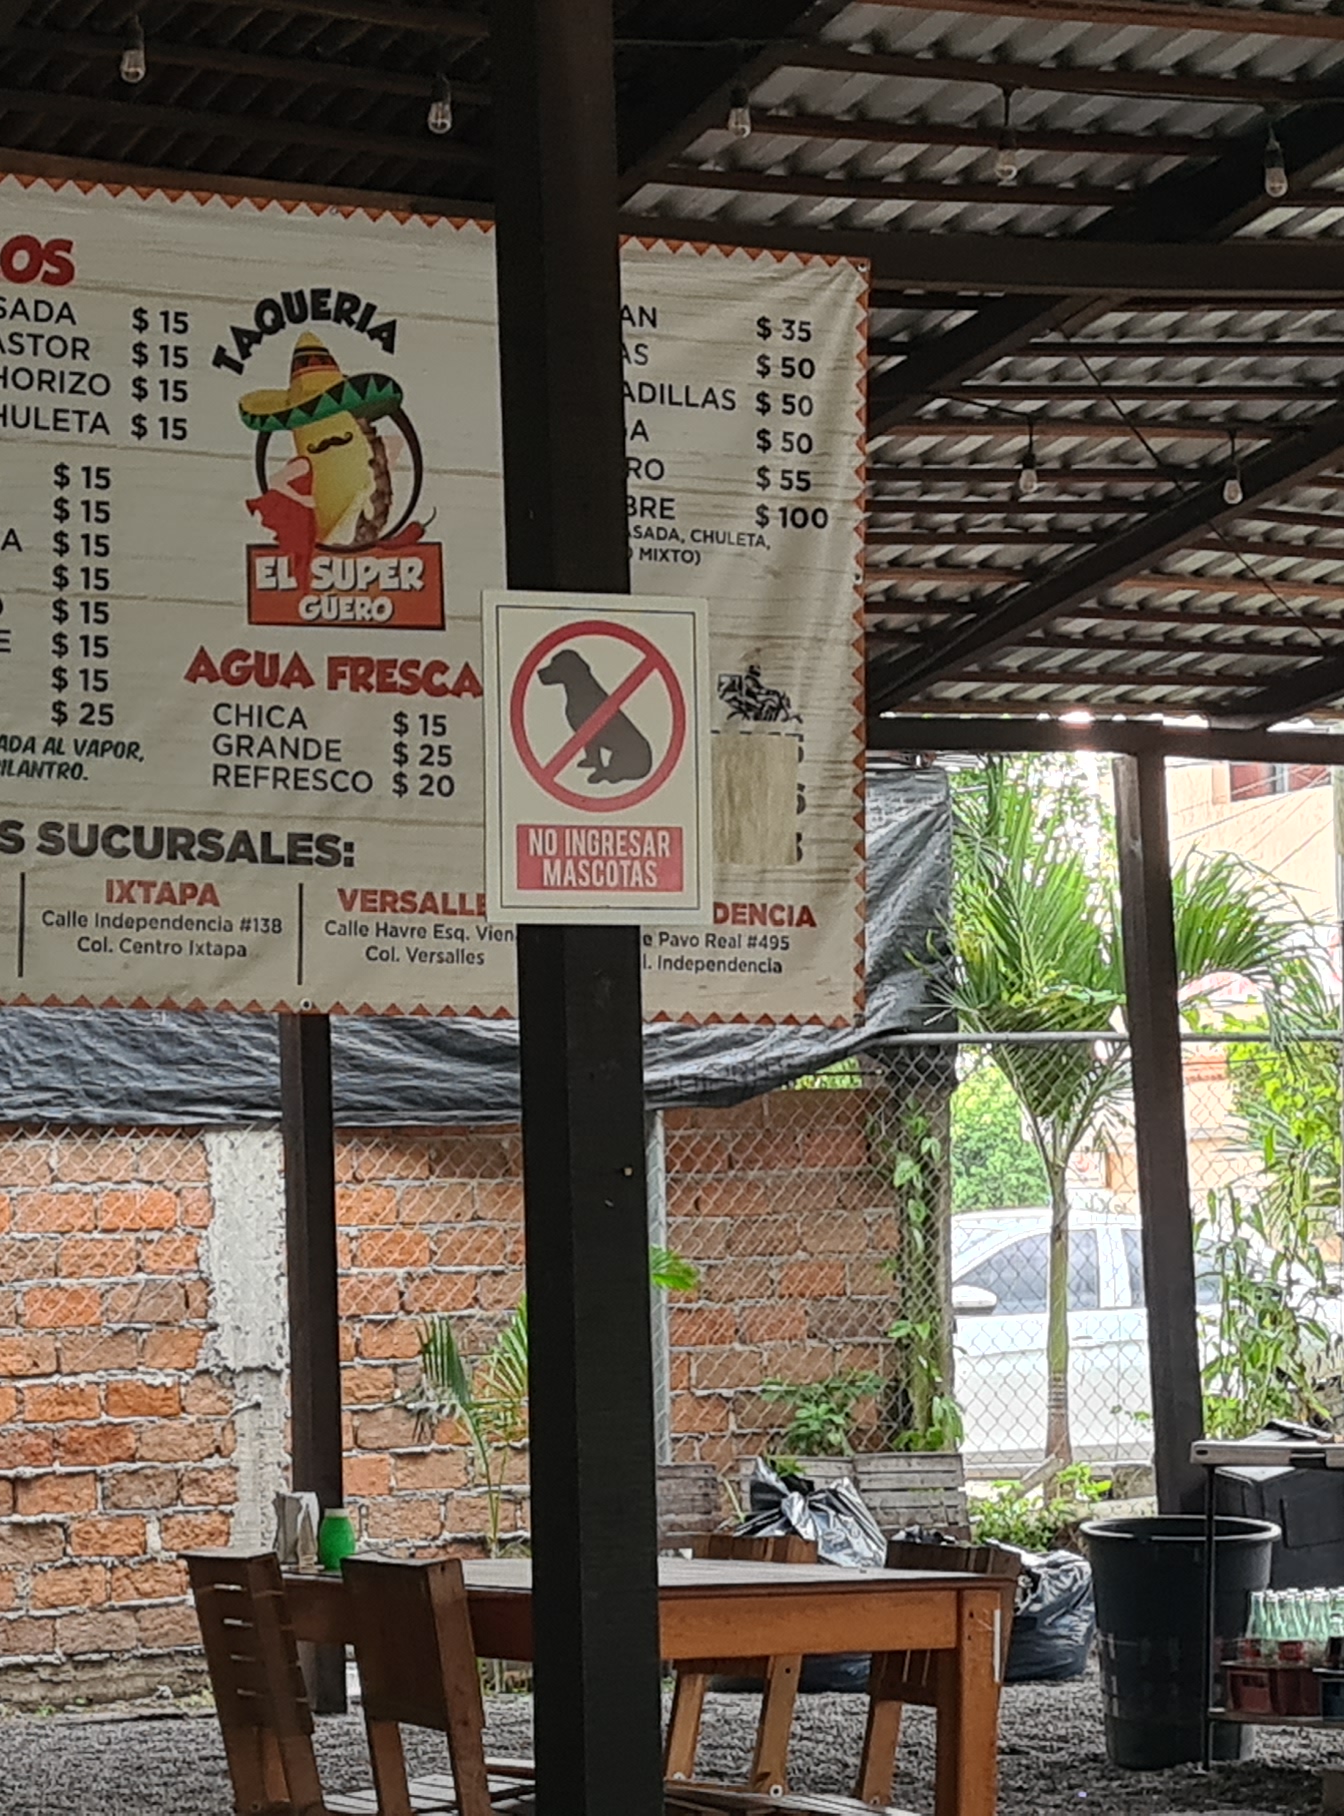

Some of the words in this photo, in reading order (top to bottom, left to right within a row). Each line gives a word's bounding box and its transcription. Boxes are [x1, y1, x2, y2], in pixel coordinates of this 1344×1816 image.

[132, 306, 150, 335] $
[159, 310, 189, 335] 15
[212, 288, 397, 375] TAQUERIA
[620, 304, 657, 329] AN
[756, 315, 773, 341] $
[781, 318, 812, 343] 35
[131, 340, 149, 369] $
[159, 344, 189, 369] 15
[622, 342, 648, 366] AS
[756, 353, 771, 380] $
[780, 356, 816, 380] 50
[131, 375, 149, 403] $
[158, 378, 188, 403] 15
[622, 382, 737, 411] ADILLAS
[755, 390, 772, 417] $
[781, 393, 814, 417] 50
[130, 413, 148, 441] $
[158, 416, 188, 441] 15
[756, 427, 772, 454] $
[781, 431, 814, 455] 50
[53, 462, 71, 491] $
[81, 465, 111, 491] 15
[627, 458, 664, 481] RO
[756, 464, 771, 492] $
[779, 469, 812, 493] 55
[53, 496, 71, 524] $
[80, 499, 111, 524] 15
[625, 496, 676, 520] BRE
[755, 503, 770, 529] $
[778, 506, 829, 530] 100
[52, 529, 70, 558] $
[80, 532, 110, 558] 15
[626, 526, 685, 543] SADA,
[689, 528, 771, 551] CHULETA,
[639, 546, 701, 566] MIXTO)
[52, 563, 70, 592] $
[80, 566, 110, 591] 15
[255, 556, 297, 589] EL
[310, 557, 424, 591] SUPER
[52, 596, 70, 626] $
[79, 600, 110, 625] 15
[51, 631, 69, 659] $
[79, 634, 109, 659] 15
[51, 665, 69, 694] $
[78, 668, 109, 693] 15
[183, 645, 316, 690] AGUA
[326, 655, 485, 699] FRESCA
[50, 699, 69, 728] $
[78, 701, 114, 727] 25
[212, 702, 308, 731] CHICA
[393, 710, 409, 738] $
[418, 713, 447, 738] 15
[41, 736, 66, 756] AL
[73, 738, 145, 763] VAPOR,
[212, 733, 342, 763] GRANDE
[392, 740, 409, 768] $
[418, 743, 453, 768] 25
[212, 763, 374, 794] REFRESCO
[392, 770, 409, 799] $
[418, 773, 455, 798] 20
[35, 821, 355, 868] SUCURSALES:
[529, 828, 556, 856] NO
[565, 829, 670, 858] INGRESAR
[543, 859, 657, 887] MASCOTAS
[105, 879, 221, 908] IXTAPA
[337, 887, 486, 916] VERSALLE
[41, 909, 89, 928] Calle
[94, 912, 234, 933] Independencia
[239, 917, 283, 935] #138
[712, 901, 818, 929] DENCIA
[324, 919, 370, 938] Calle
[375, 921, 427, 940] Havre
[433, 923, 470, 943] Esq.
[475, 924, 514, 942] Vien
[658, 931, 700, 948] Pavo
[704, 932, 742, 949] Real
[746, 934, 790, 951] #495
[77, 935, 114, 953] Col.
[118, 937, 183, 956] Centro
[189, 939, 248, 960] Ixtapa
[365, 945, 400, 963] Col.
[405, 946, 485, 966] Versalles
[657, 954, 783, 974] Independencia
